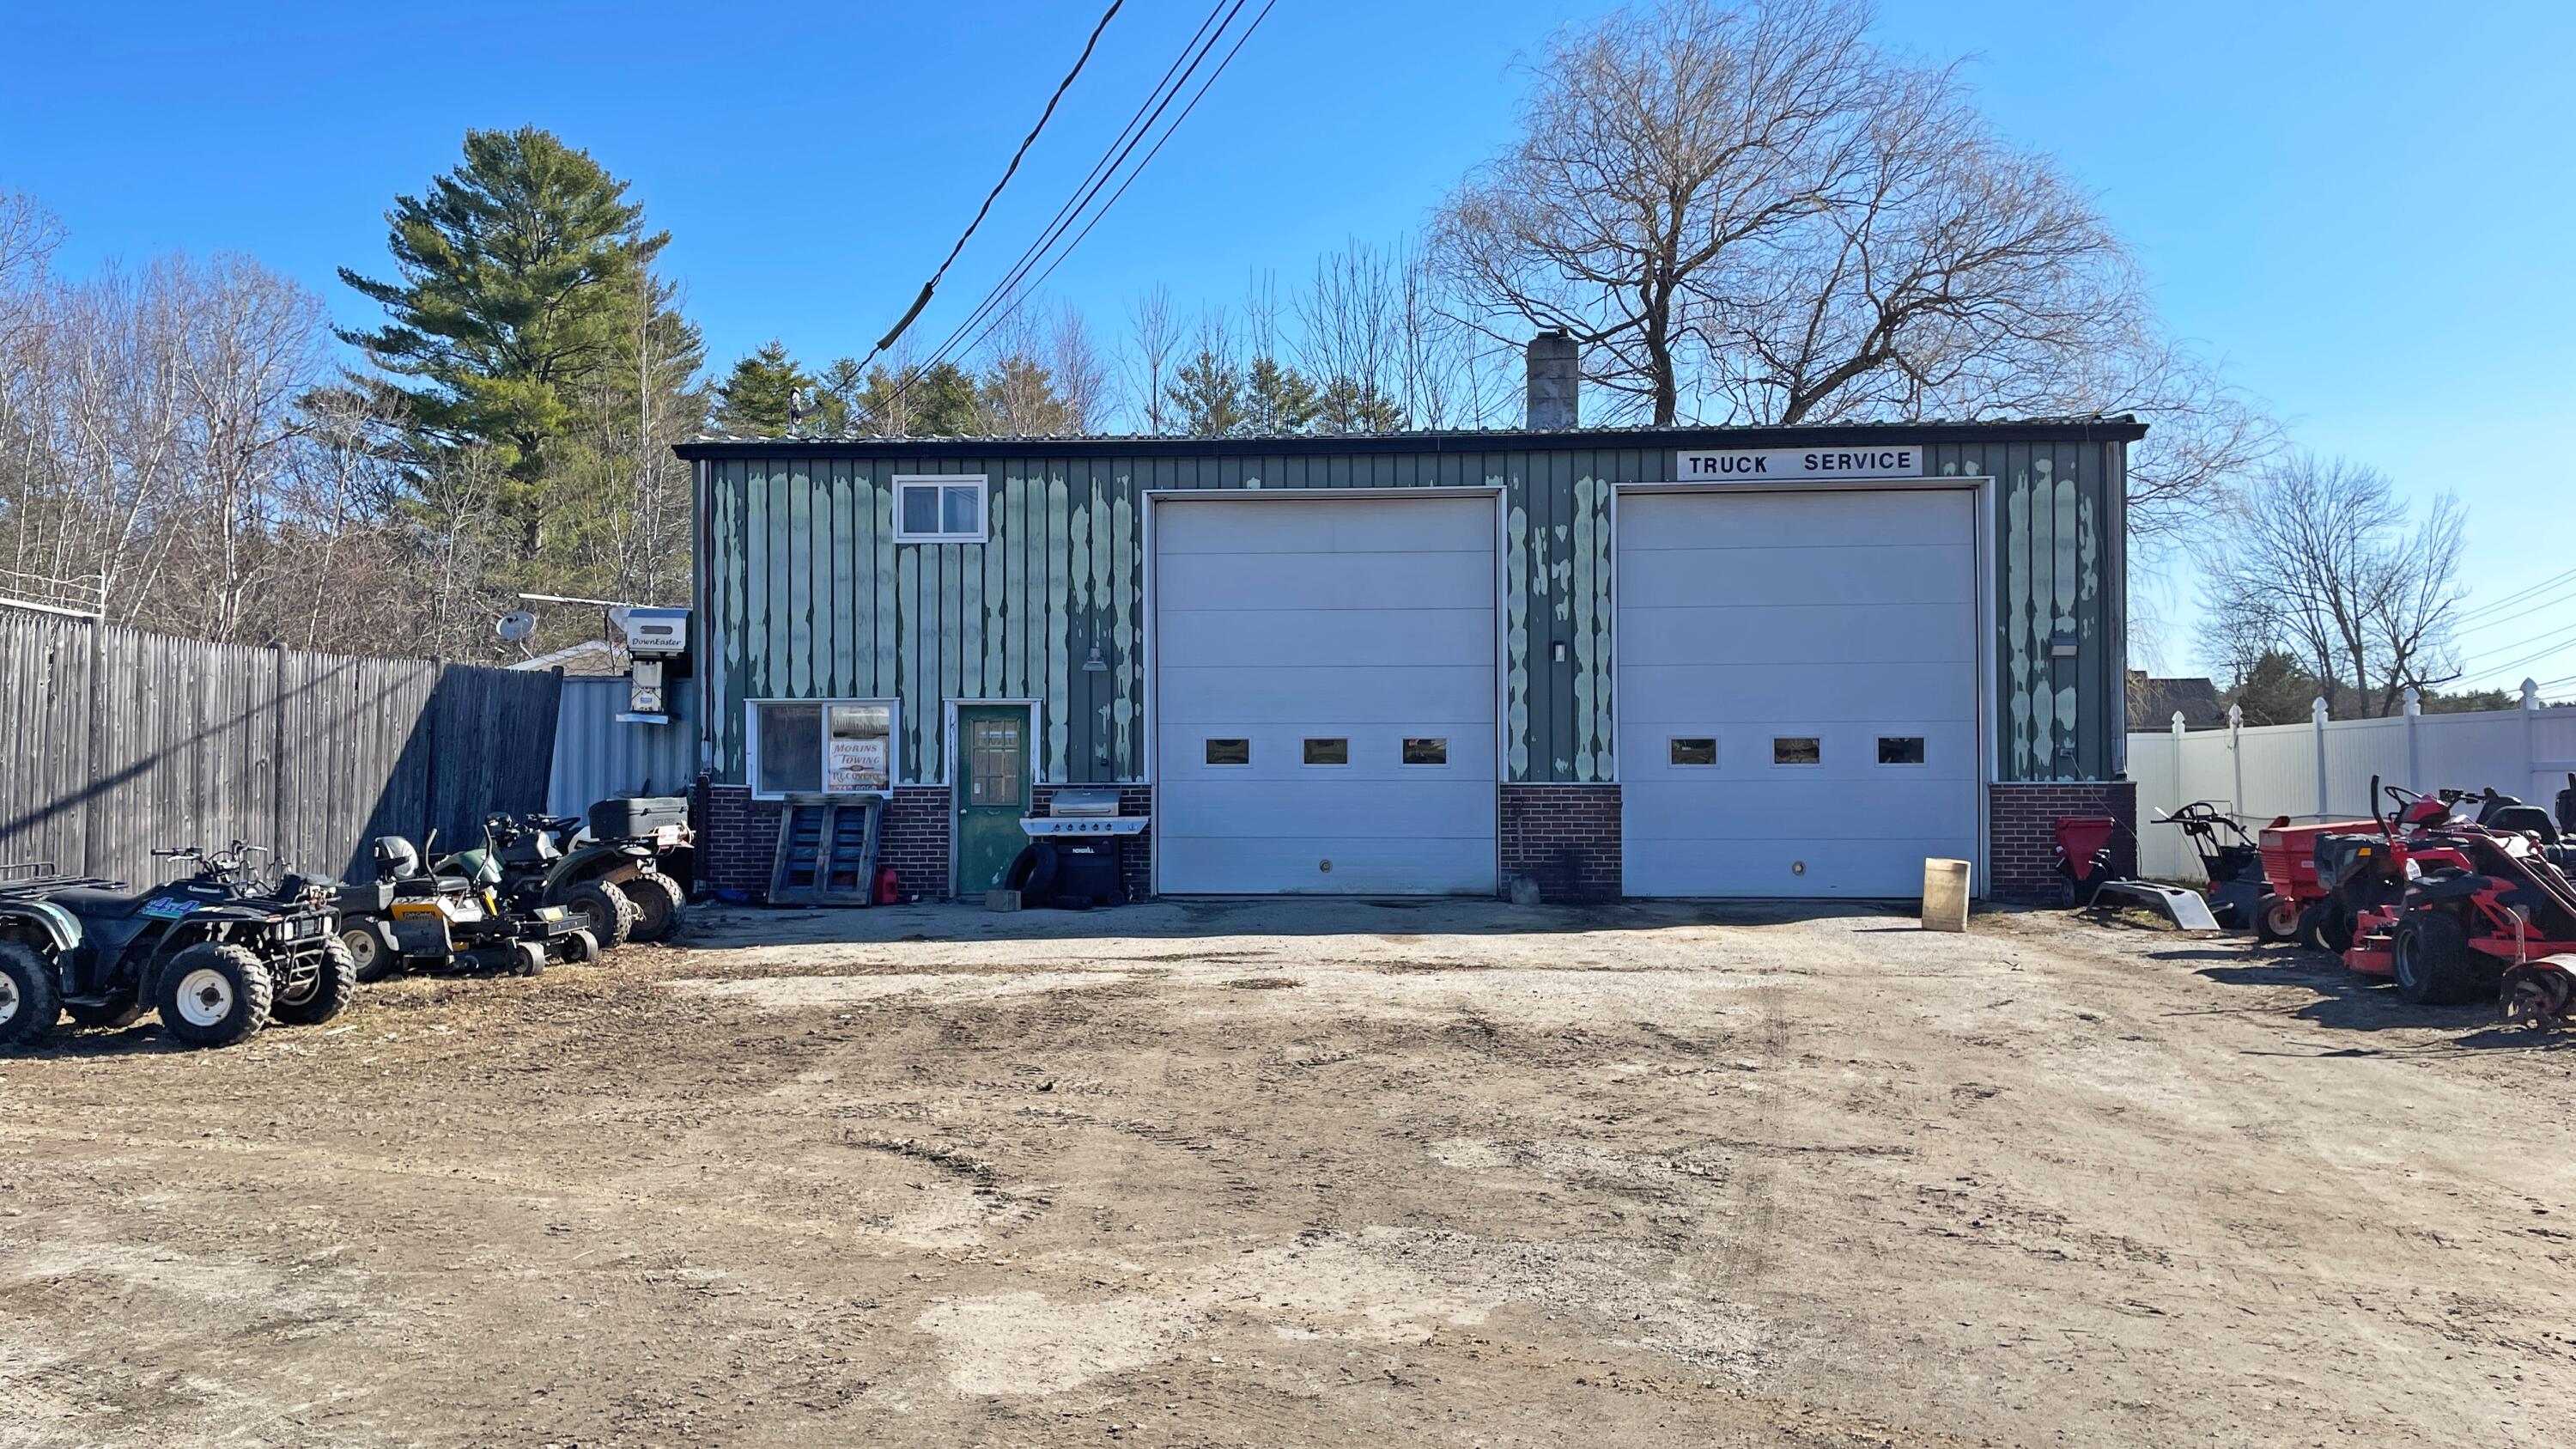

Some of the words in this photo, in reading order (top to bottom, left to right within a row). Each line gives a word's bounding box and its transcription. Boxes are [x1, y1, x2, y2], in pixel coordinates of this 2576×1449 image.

[1689, 456, 1768, 473] TRUCK
[1804, 452, 1911, 471] SERVICE
[632, 637, 682, 646] DownEaster
[834, 755, 879, 764] TOWING
